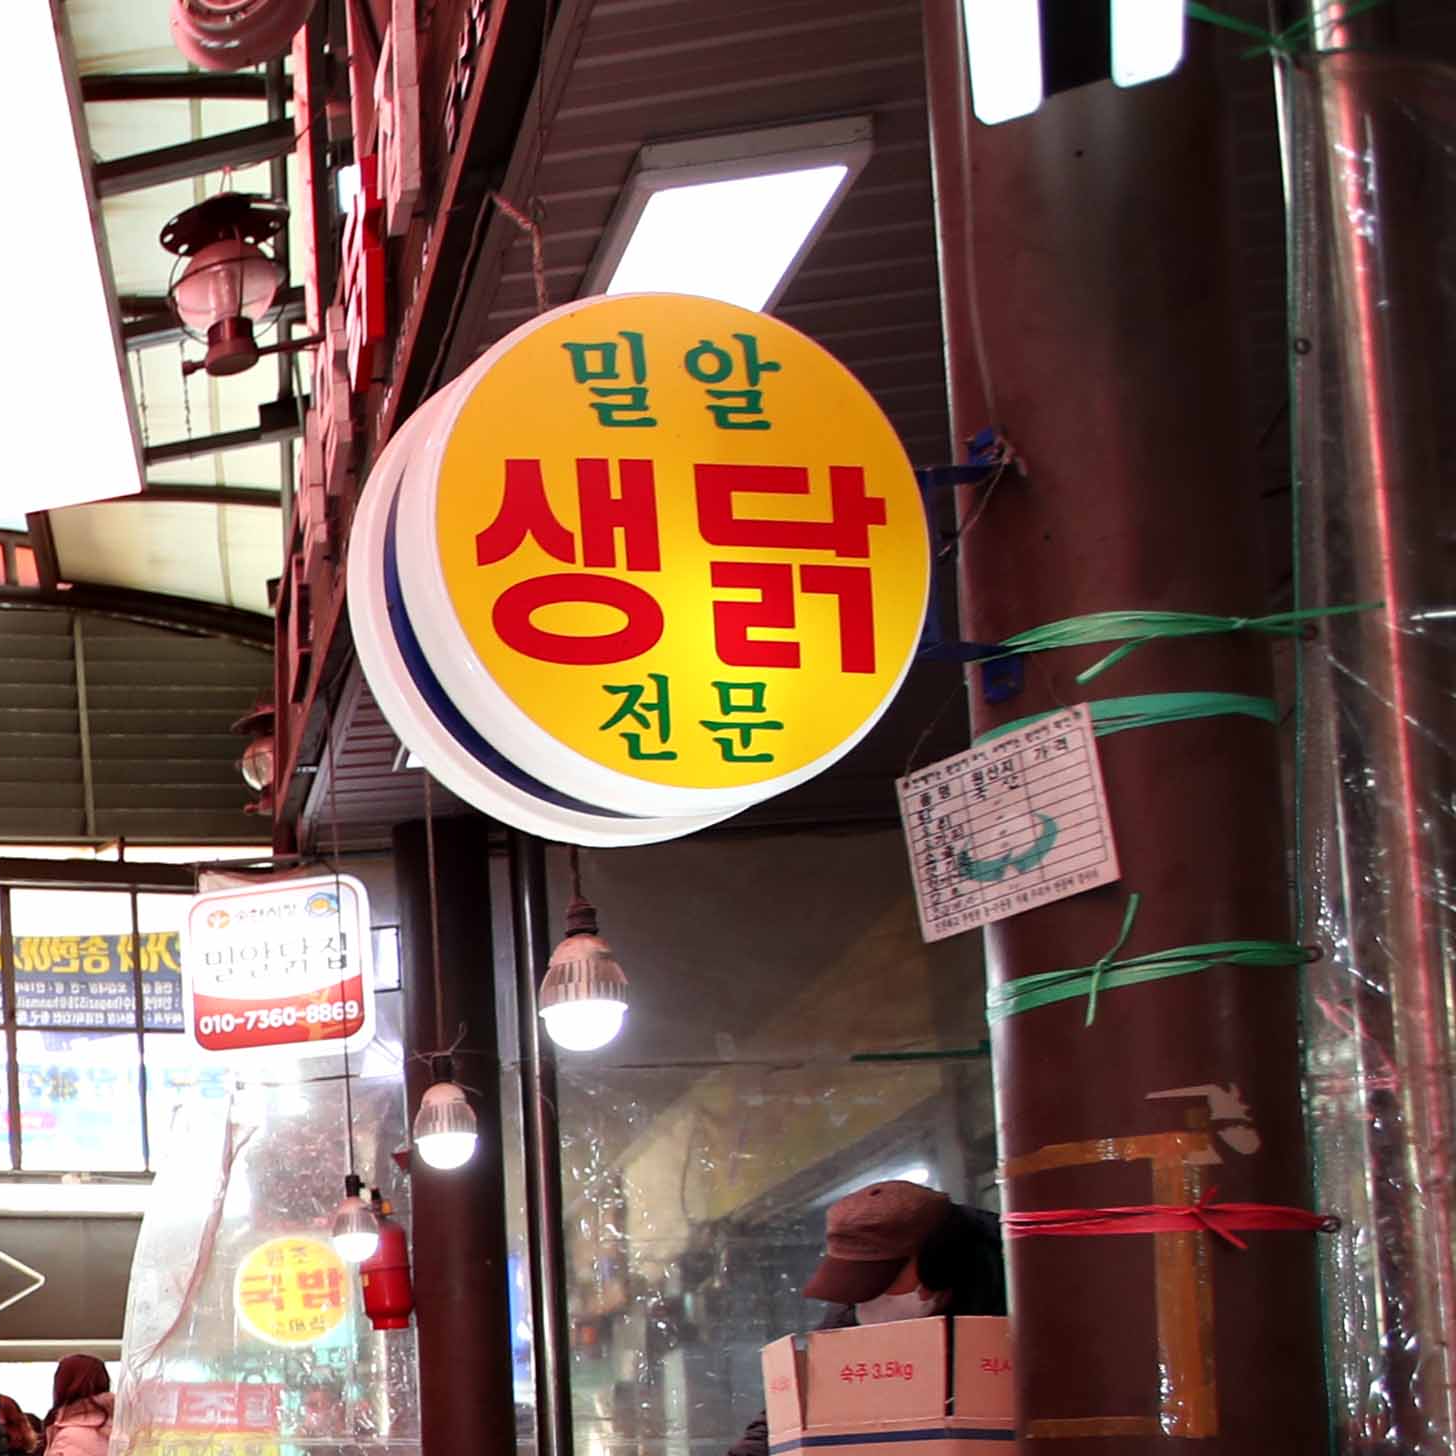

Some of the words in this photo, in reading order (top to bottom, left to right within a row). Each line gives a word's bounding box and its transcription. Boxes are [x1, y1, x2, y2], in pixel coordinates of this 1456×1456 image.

[561, 331, 781, 430] 밀알
[475, 457, 887, 674] 생닭
[600, 672, 785, 763] 전문
[199, 999, 360, 1036] 010-7360-8869
[840, 1363, 870, 1384] 숙주
[872, 1359, 914, 1381] 3.5kg
